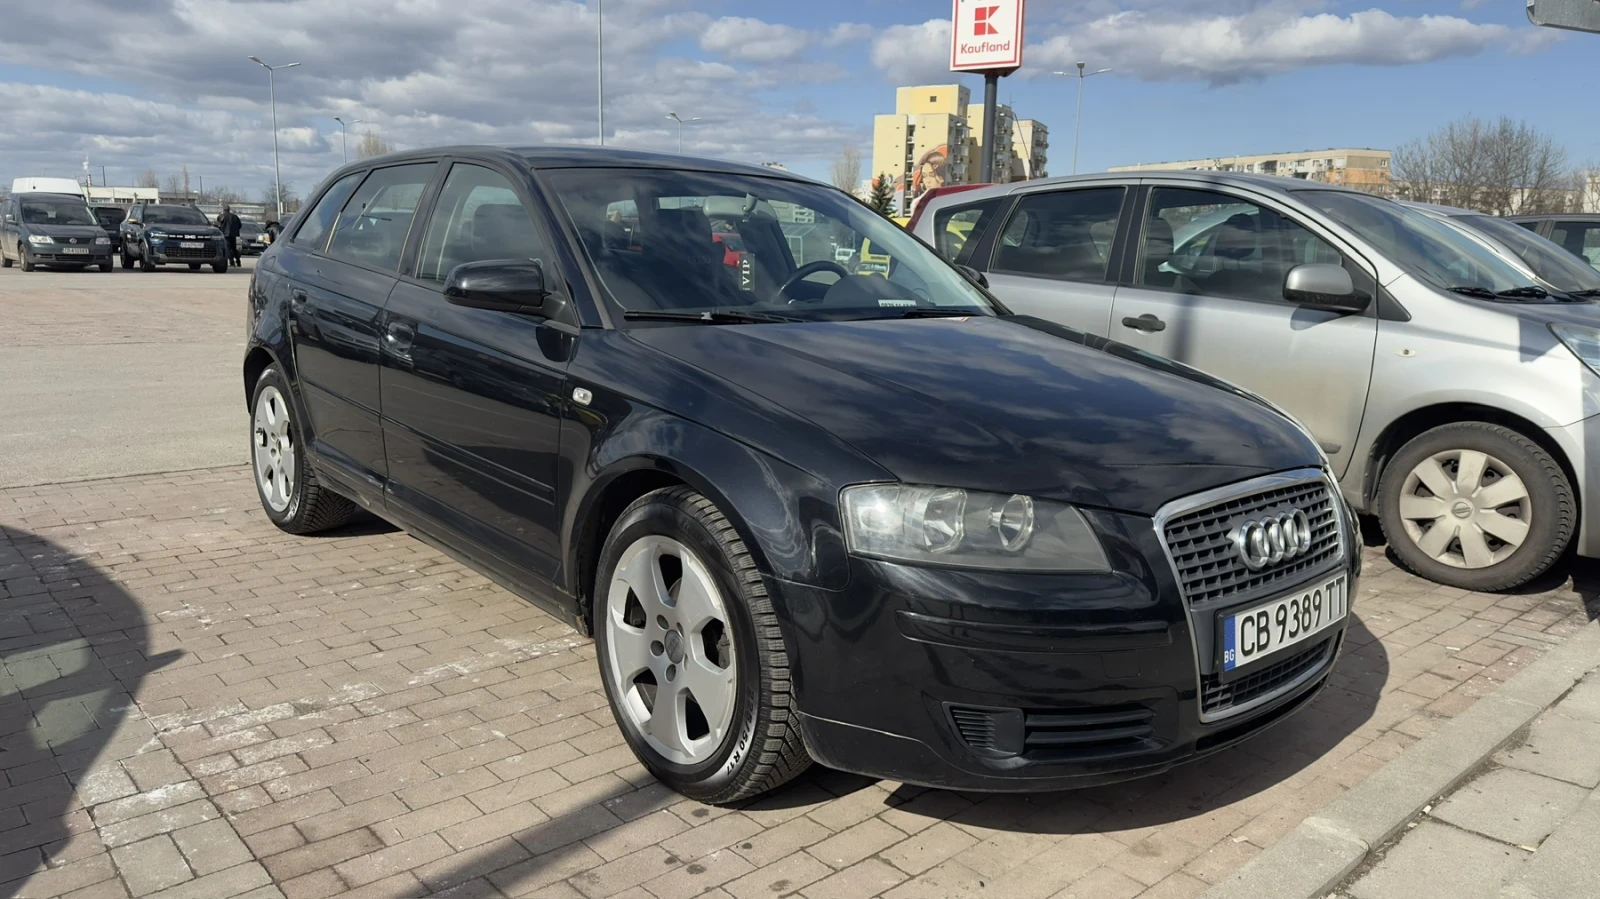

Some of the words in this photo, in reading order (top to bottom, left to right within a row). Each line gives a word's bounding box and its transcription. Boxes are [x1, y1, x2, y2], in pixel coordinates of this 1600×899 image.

[960, 40, 1010, 54] Kaufland
[742, 259, 750, 286] VIP
[1240, 609, 1271, 657] CB
[1275, 589, 1322, 644] 9389
[1325, 576, 1345, 621] TT
[1224, 649, 1235, 664] BG
